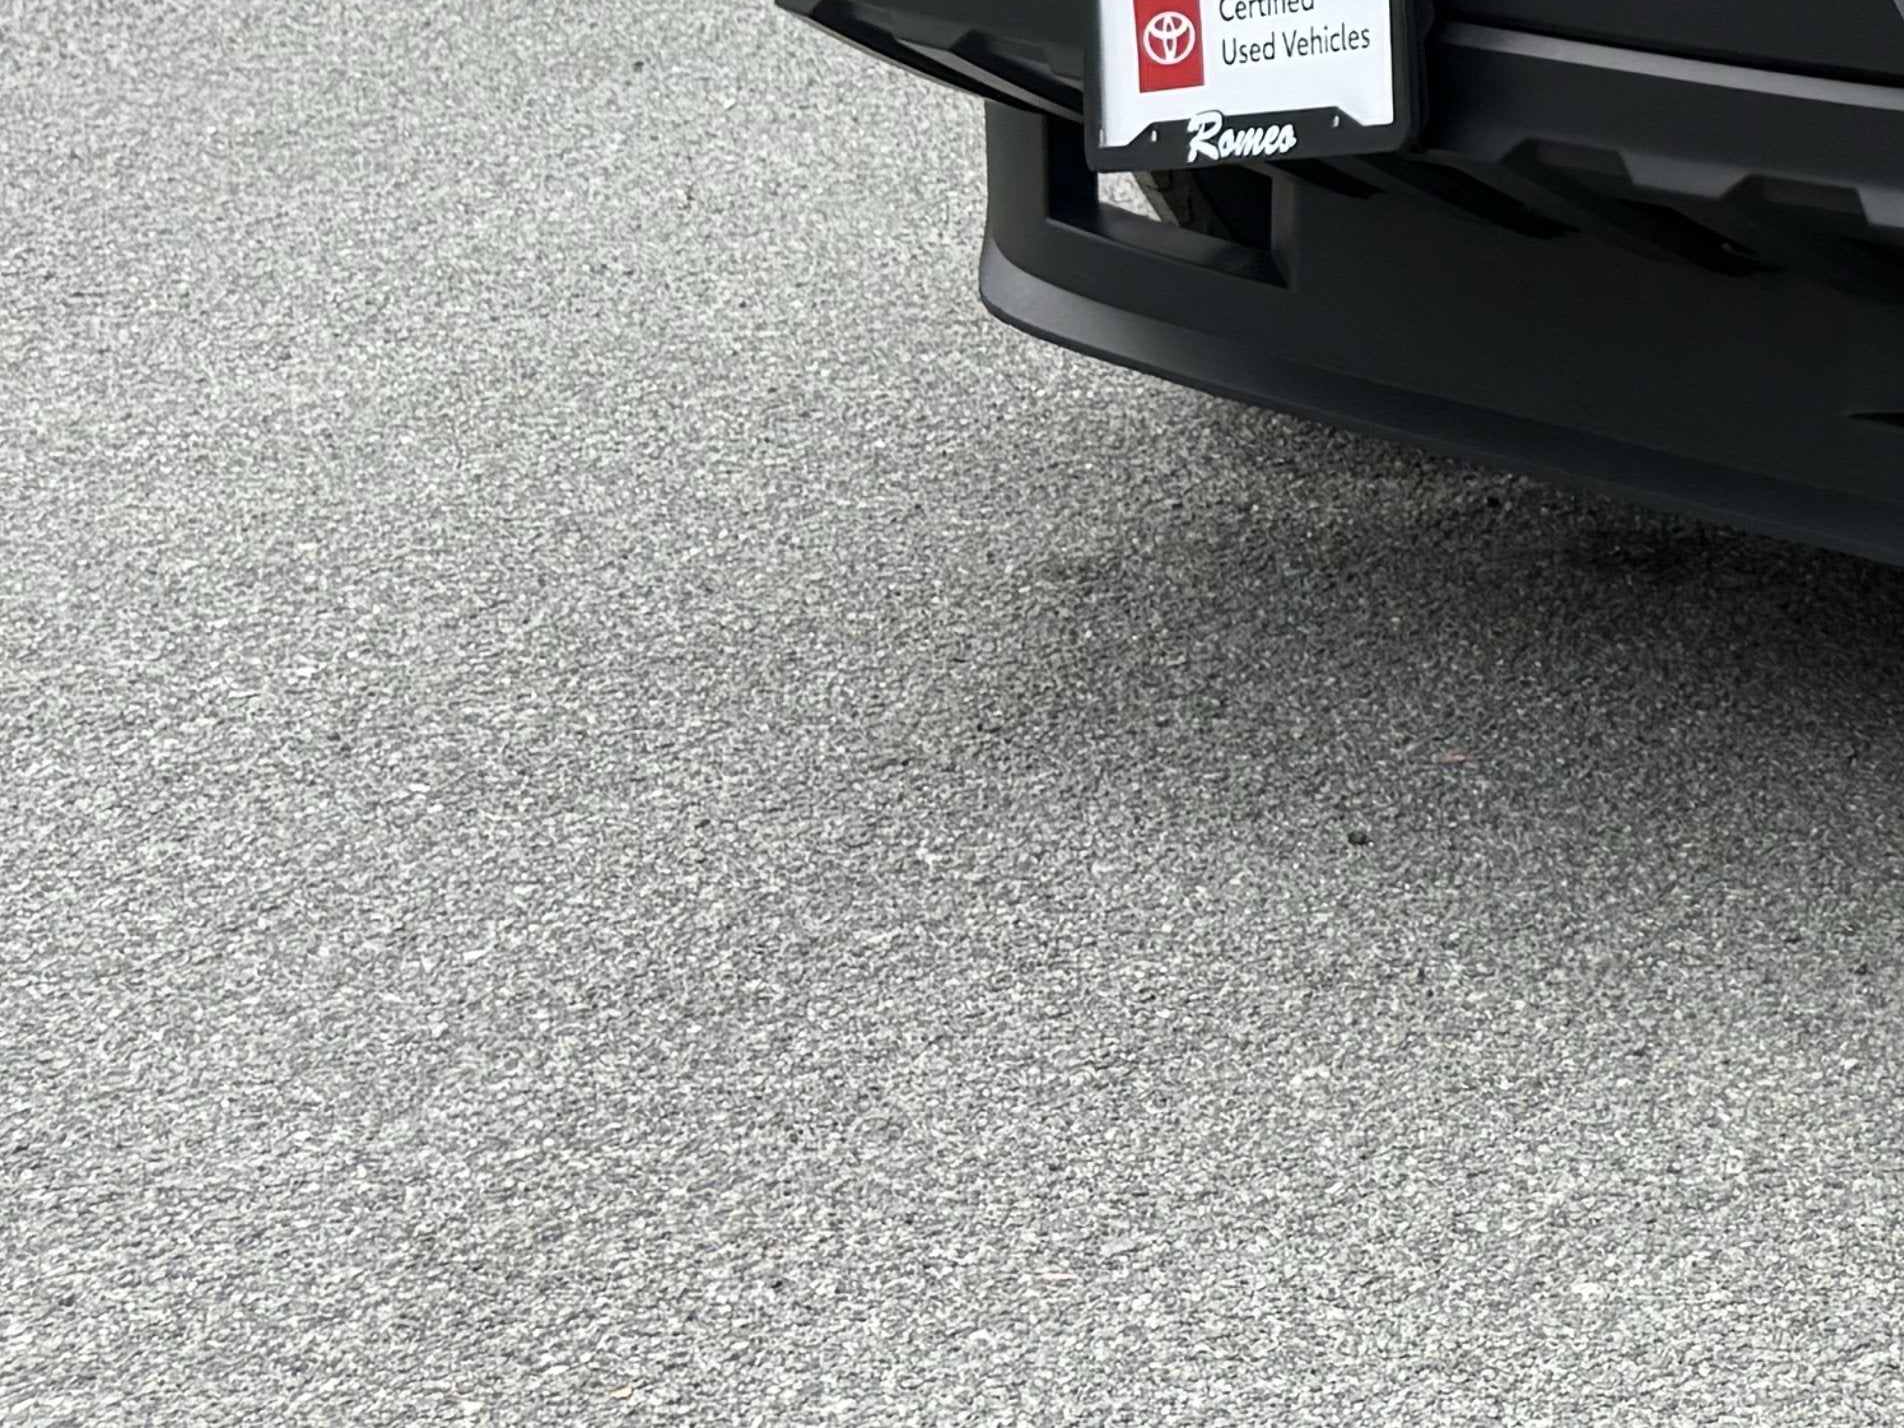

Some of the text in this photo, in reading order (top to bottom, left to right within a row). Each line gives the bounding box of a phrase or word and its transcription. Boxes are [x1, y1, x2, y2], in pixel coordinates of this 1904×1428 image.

[1221, 22, 1371, 66] Used Vehicles
[1186, 109, 1298, 163] Romeo
